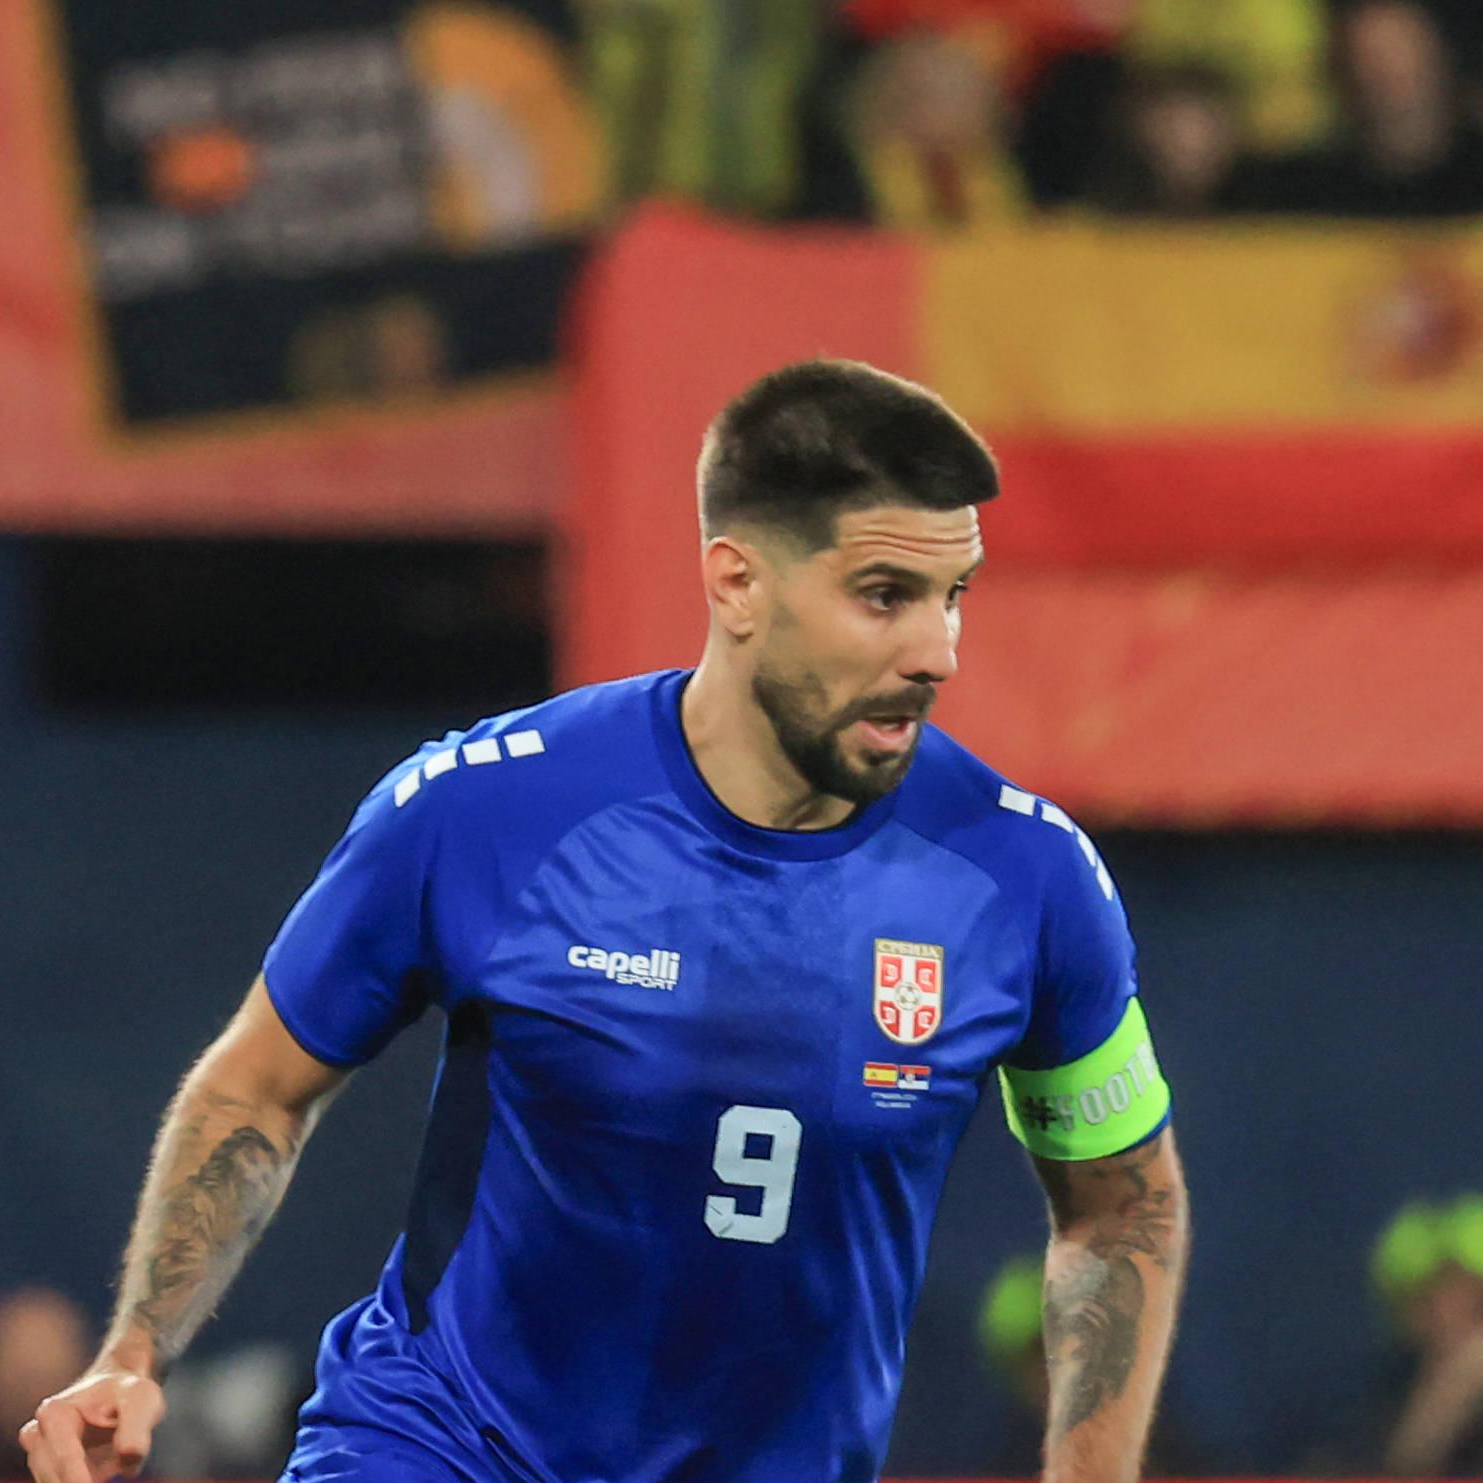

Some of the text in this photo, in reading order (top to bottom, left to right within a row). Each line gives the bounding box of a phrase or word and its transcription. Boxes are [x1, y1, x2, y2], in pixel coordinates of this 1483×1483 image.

[567, 945, 681, 980] capelli
[615, 973, 678, 991] SPORT
[704, 1104, 803, 1244] 9
